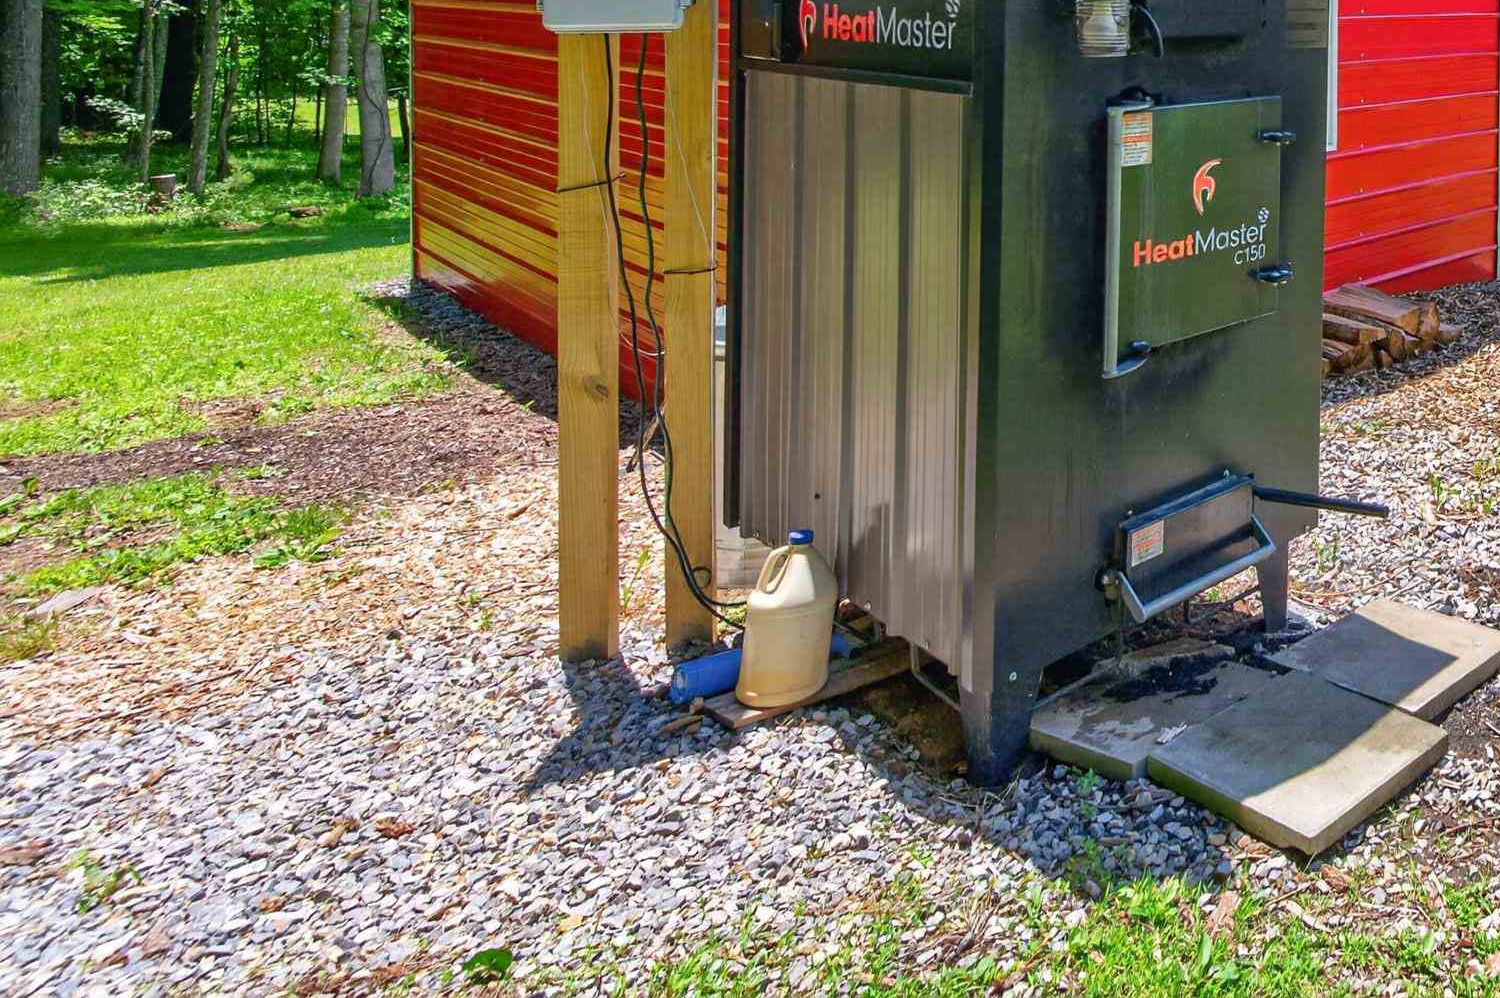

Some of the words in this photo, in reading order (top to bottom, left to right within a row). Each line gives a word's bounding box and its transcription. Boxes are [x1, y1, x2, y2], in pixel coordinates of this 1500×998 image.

[822, 3, 957, 50] HeatMaster
[1133, 222, 1268, 267] HeatMaster
[1233, 243, 1266, 265] C150
